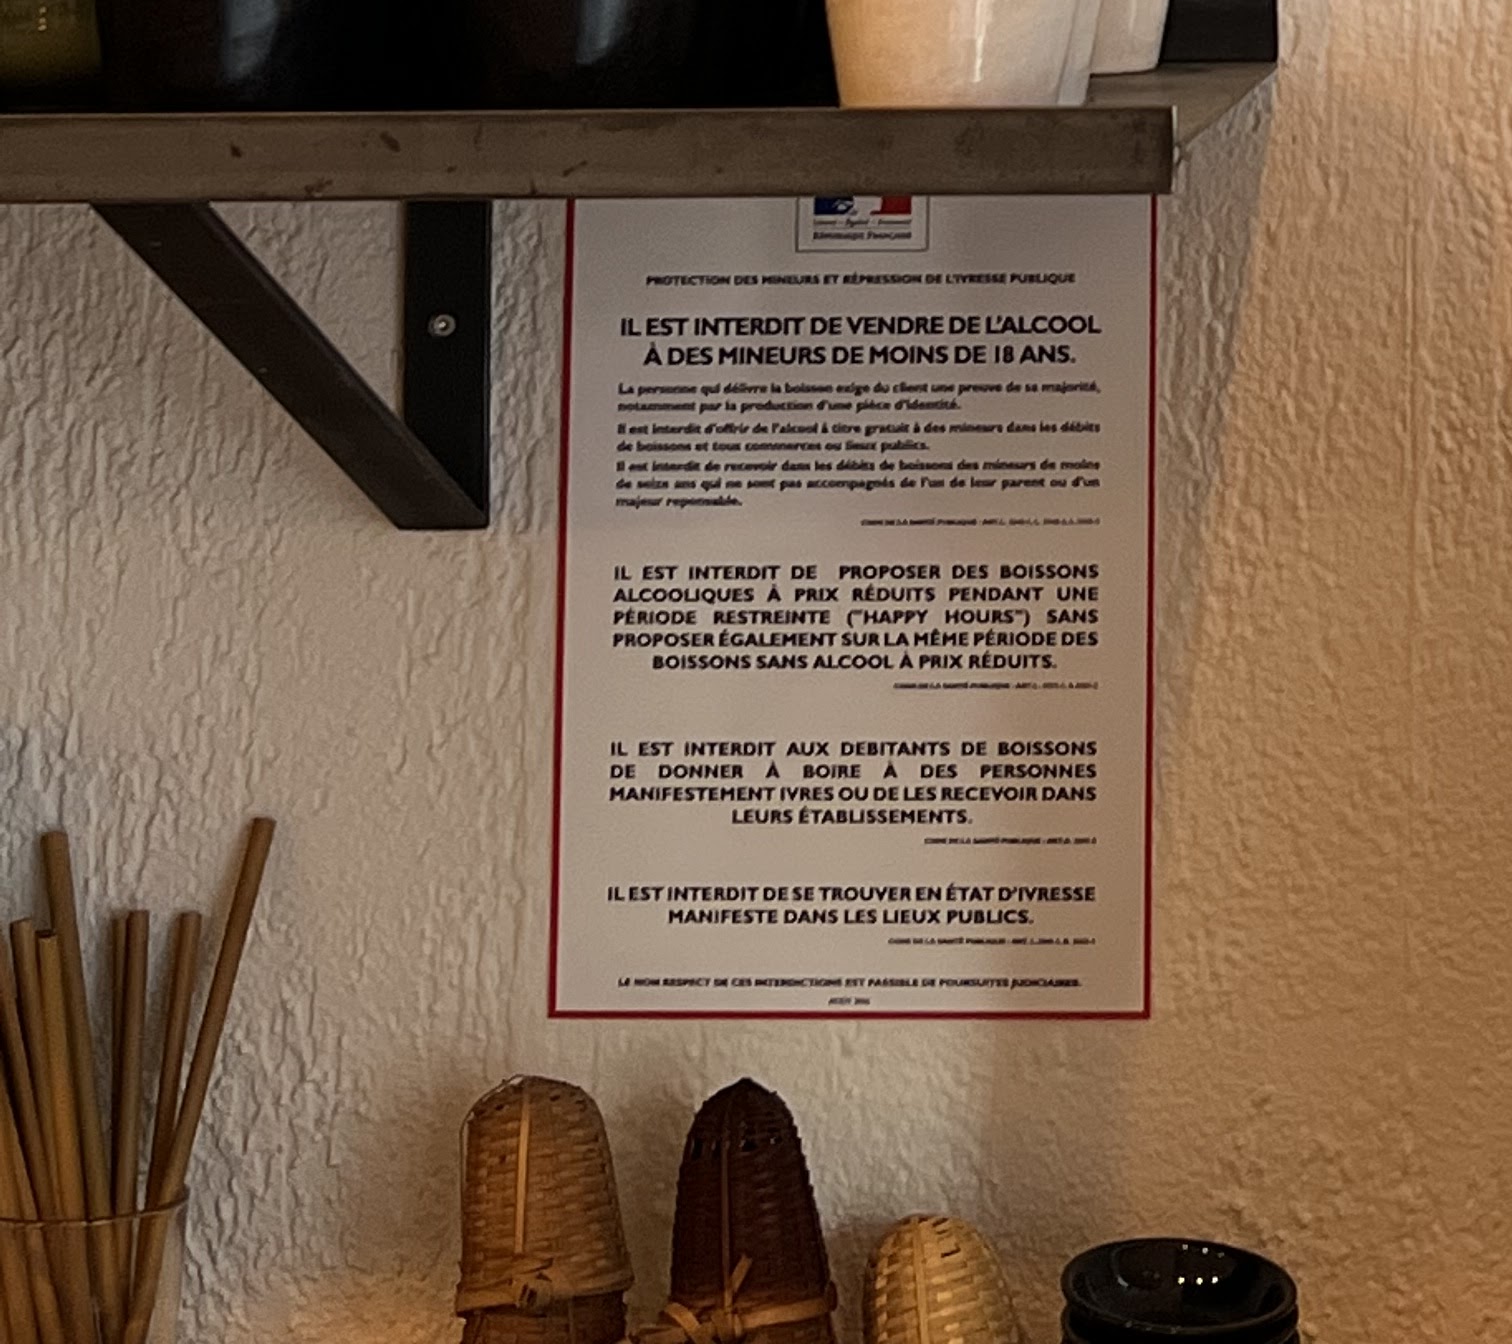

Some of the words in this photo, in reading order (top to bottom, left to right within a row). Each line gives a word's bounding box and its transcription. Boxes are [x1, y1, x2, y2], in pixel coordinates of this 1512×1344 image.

[621, 318, 641, 336] IL
[646, 317, 689, 336] EST
[694, 317, 806, 336] INTERDIT
[810, 316, 842, 335] DE
[846, 316, 944, 335] VENDRE
[949, 316, 981, 335] DE
[986, 315, 1102, 334] L'ALCOOL
[643, 342, 662, 365] À
[668, 347, 713, 365] DES
[719, 347, 826, 365] MINEURS
[832, 345, 864, 364] DE
[869, 345, 948, 364] MOINS
[954, 345, 986, 364] DE
[995, 345, 1014, 364] 18
[1019, 345, 1076, 364] ANS.
[615, 566, 631, 580] IL
[643, 566, 678, 580] EST
[689, 566, 780, 580] INTERDIT
[791, 565, 817, 579] DE
[839, 565, 940, 579] PROPOSER
[952, 565, 988, 579] DES
[1000, 565, 1099, 579] BOISSONS
[613, 588, 754, 605] ALCOOLIQUES
[767, 585, 781, 603] À
[795, 587, 838, 601] PRIX
[852, 583, 935, 602] RÉDUITS
[949, 587, 1044, 602] PENDANT
[1057, 587, 1098, 602] UNE
[613, 607, 696, 625] PÉRIODE
[714, 610, 830, 624] RESTREINTE
[1047, 609, 1098, 624] SANS
[613, 632, 714, 647] PROPOSER
[719, 629, 837, 647] ÉGALEMENT
[841, 632, 880, 647] SUR
[884, 633, 909, 647] LA
[914, 629, 969, 647] MÊME
[974, 629, 1057, 647] PÉRIODE
[1062, 632, 1098, 646] DES
[653, 655, 751, 670] BOISSONS
[756, 655, 808, 670] SANS
[813, 655, 894, 669] ALCOOL
[899, 651, 913, 669] À
[919, 655, 962, 669] PRIX
[969, 651, 1057, 669] RÉDUITS.
[611, 742, 628, 756] IL
[639, 742, 674, 756] EST
[684, 742, 776, 757] INTERDIT
[787, 742, 829, 757] AUX
[961, 741, 987, 756] DE
[998, 741, 1097, 756] BOISSONS
[610, 764, 635, 779] DE
[659, 764, 743, 779] DONNER
[765, 761, 780, 778] À
[803, 764, 861, 779] BOIRE
[883, 761, 897, 779] À
[921, 764, 958, 779] DES
[980, 764, 1096, 779] PERSONNES
[609, 787, 776, 801] MANIFESTEMENT
[780, 787, 834, 801] IVRES
[838, 787, 868, 801] OU
[873, 787, 898, 801] DE
[904, 787, 936, 801] LES
[941, 786, 1037, 801] RECEVOIR
[1042, 787, 1096, 801] DANS
[732, 809, 793, 824] LEURS
[799, 806, 972, 824] ÉTABLISSEMENTS.
[608, 887, 625, 901] IL
[629, 887, 664, 901] EST
[668, 887, 759, 902] INTERDIT
[763, 887, 788, 902] DE
[793, 887, 814, 901] SE
[819, 886, 911, 901] TROUVER
[916, 886, 941, 901] EN
[946, 883, 994, 901] ÉTAT
[998, 886, 1095, 902] D'IVRESSE
[669, 909, 777, 924] MANIFESTE
[784, 909, 838, 924] DANS
[844, 909, 877, 924] LES
[883, 909, 940, 924] LIEUX
[947, 909, 1034, 924] PUBLICS.
